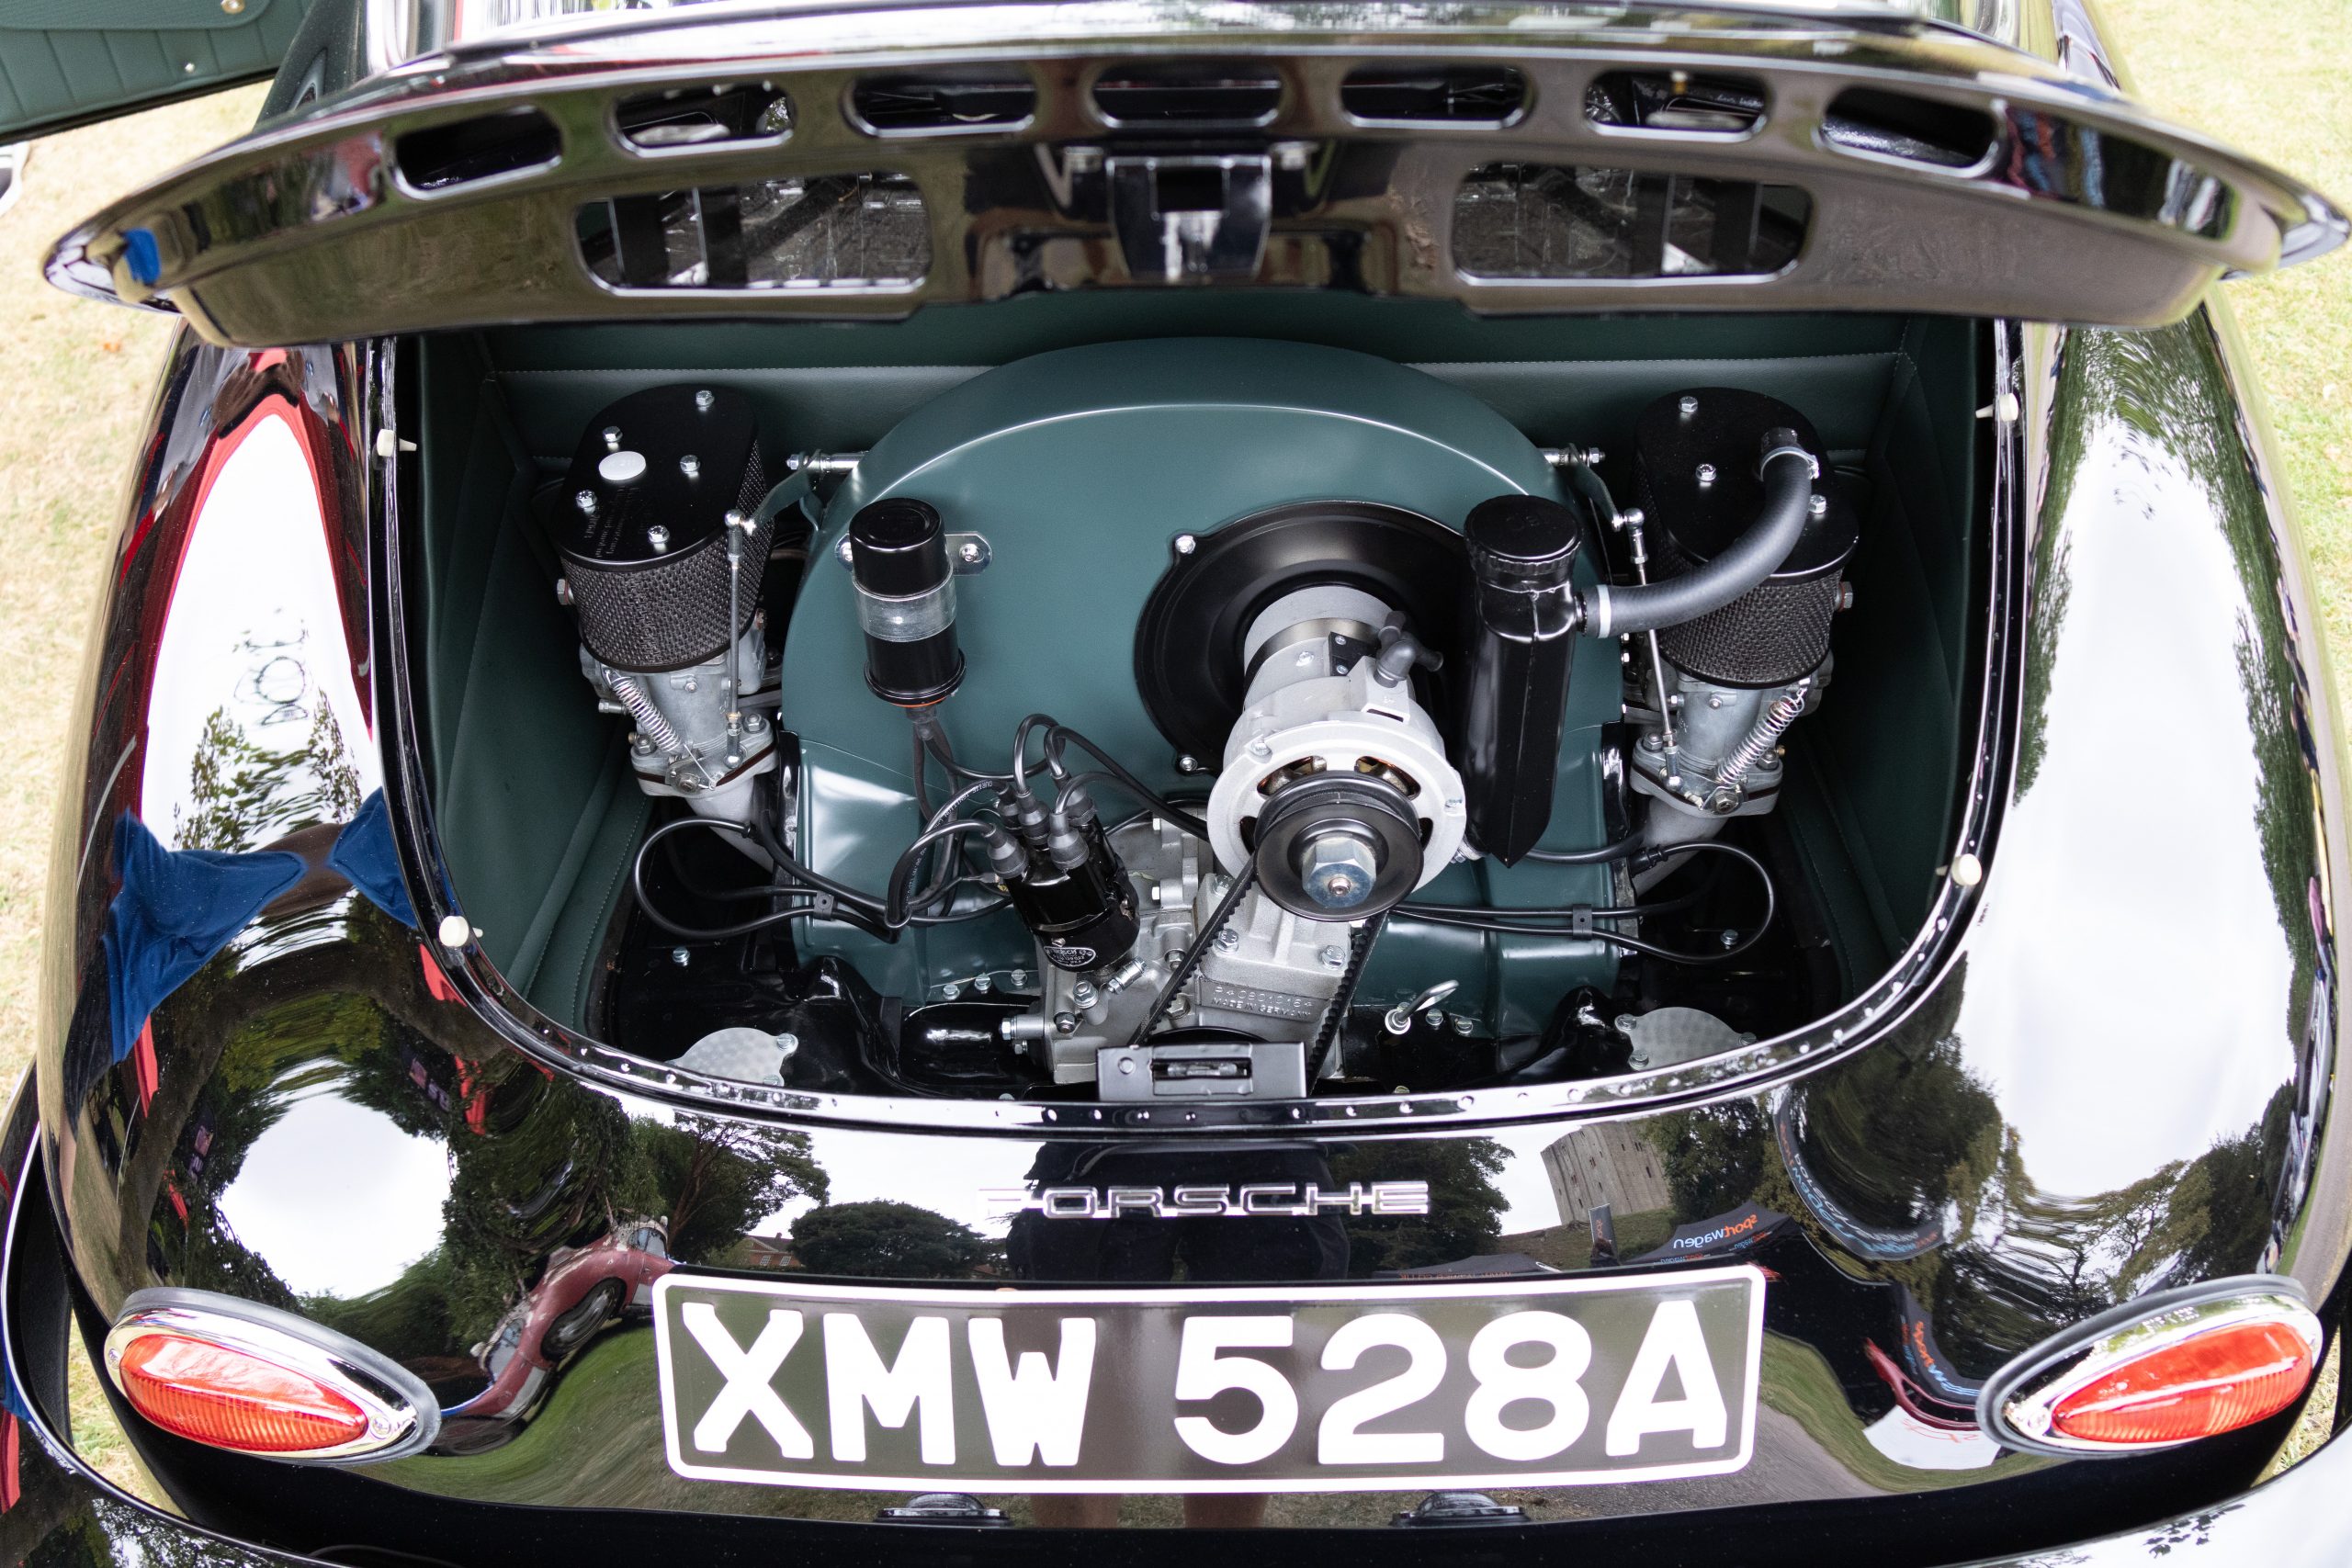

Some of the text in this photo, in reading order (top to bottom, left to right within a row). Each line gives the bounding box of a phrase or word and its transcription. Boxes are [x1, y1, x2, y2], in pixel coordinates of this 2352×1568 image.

[1211, 997, 1244, 1010] MADE
[1258, 1004, 1312, 1019] GERMANY
[978, 1181, 1430, 1219] PORSCHE
[680, 1298, 1729, 1468] XMW 528A
